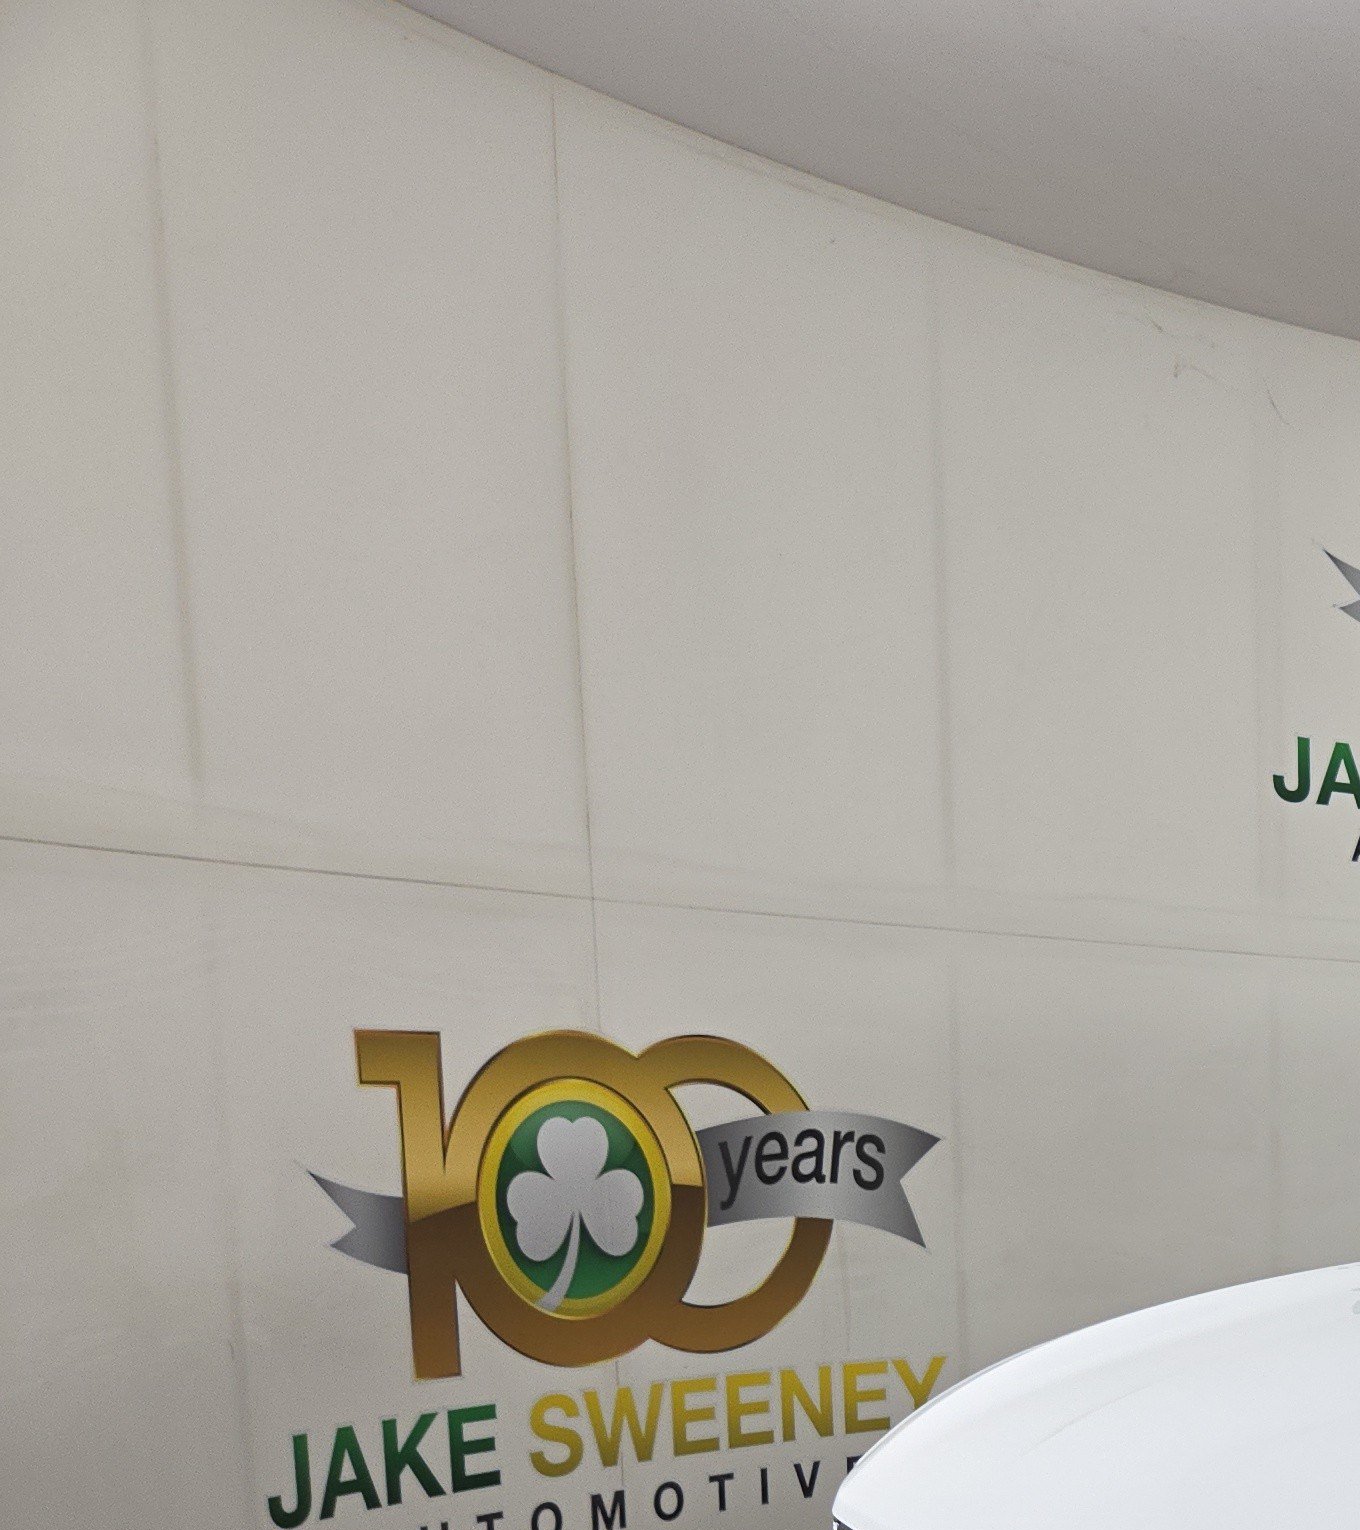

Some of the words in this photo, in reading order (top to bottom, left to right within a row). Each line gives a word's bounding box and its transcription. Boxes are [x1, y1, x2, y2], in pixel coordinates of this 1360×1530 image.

[719, 1128, 886, 1210] years
[267, 1403, 501, 1530] JAKE
[528, 1356, 946, 1478] SWEENEY
